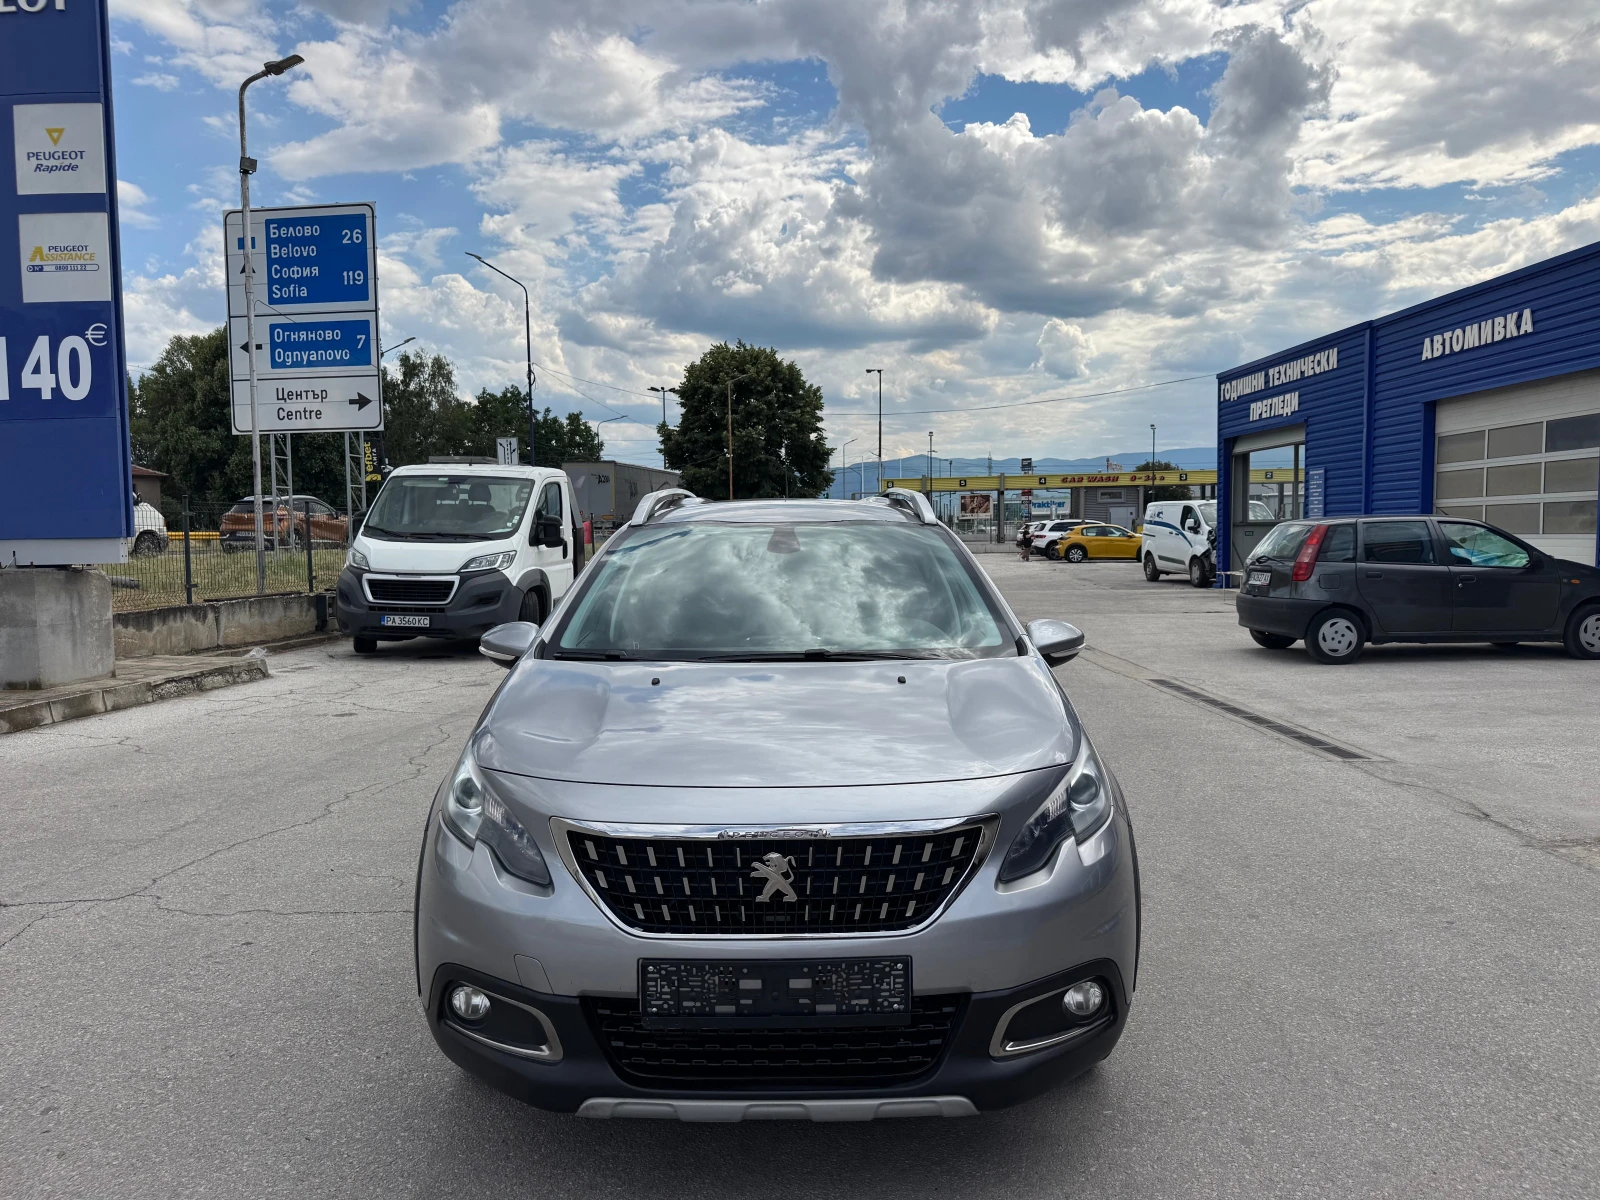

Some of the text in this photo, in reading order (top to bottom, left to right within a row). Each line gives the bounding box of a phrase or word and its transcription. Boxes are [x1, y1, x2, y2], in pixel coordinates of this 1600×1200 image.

[27, 150, 86, 161] PEUGEOT
[34, 162, 79, 174] Rapide
[269, 223, 363, 244] Белово 26
[48, 245, 89, 253] PEUGEOT
[270, 243, 317, 258] Belovo
[271, 264, 364, 285] София 119
[272, 284, 308, 299] Sofia
[274, 328, 366, 349] Огняново 7
[1421, 308, 1534, 361] АВТОМИВКА
[275, 348, 351, 366] Ognyanovo
[1220, 347, 1338, 402] ГОДИШНИ ТЕХНИЧЕСКИ
[276, 387, 328, 403] Център
[276, 407, 323, 421] Centre
[1249, 391, 1299, 422] ПРЕГЛЕДИ
[364, 441, 374, 472] efbet
[1087, 475, 1120, 483] WASH
